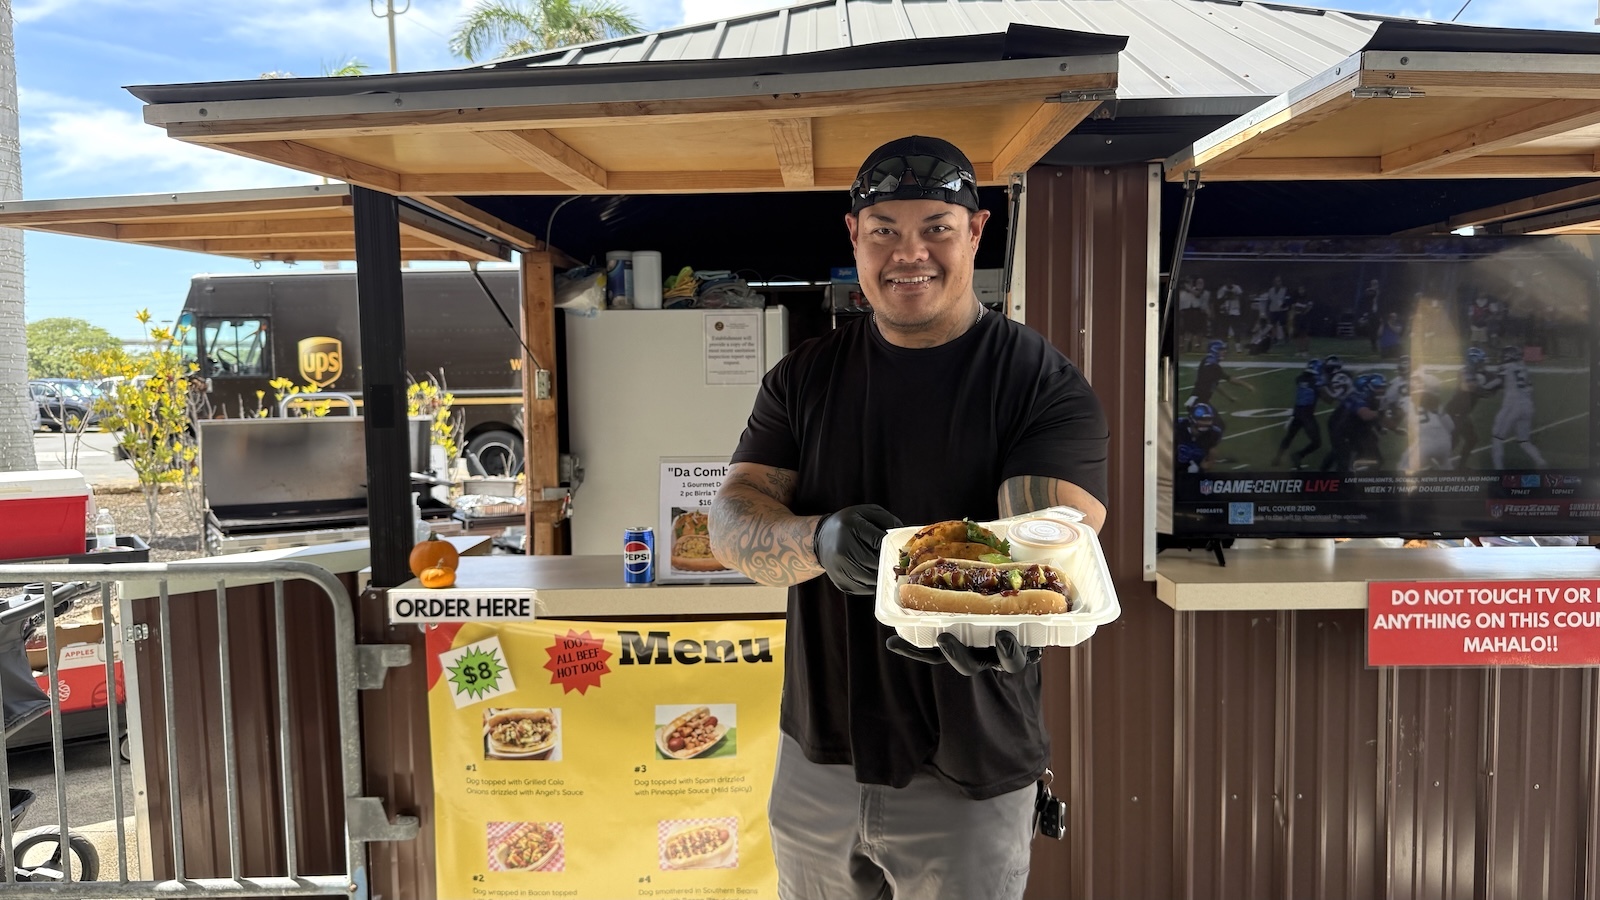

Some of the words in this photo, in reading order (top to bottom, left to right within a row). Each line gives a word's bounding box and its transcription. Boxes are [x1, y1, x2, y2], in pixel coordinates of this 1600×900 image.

[304, 352, 339, 380] ups
[1304, 479, 1340, 492] LIVE
[1391, 589, 1420, 606] DO
[1424, 589, 1464, 605] NOT
[1467, 588, 1531, 604] TOUCH
[1535, 588, 1560, 604] TV
[1564, 588, 1591, 604] OR
[396, 598, 472, 617] ORDER
[476, 598, 530, 617] HERE
[1373, 613, 1471, 630] ANYTHING
[1475, 612, 1505, 629] ON
[1509, 612, 1550, 628] THIS
[617, 631, 773, 665] Menu
[1463, 636, 1558, 653] MAHALO!!
[65, 649, 94, 658] APPLES
[557, 652, 575, 665] ALL
[576, 648, 600, 661] BEEF
[463, 661, 492, 685] $8
[557, 665, 579, 679] HOT
[581, 660, 604, 674] DOG
[466, 777, 480, 785] Dog
[695, 777, 715, 786] Spam
[536, 789, 560, 797] Angel's
[711, 787, 728, 795] (Mild
[730, 785, 752, 794] Spicy)
[473, 887, 486, 896] Dog
